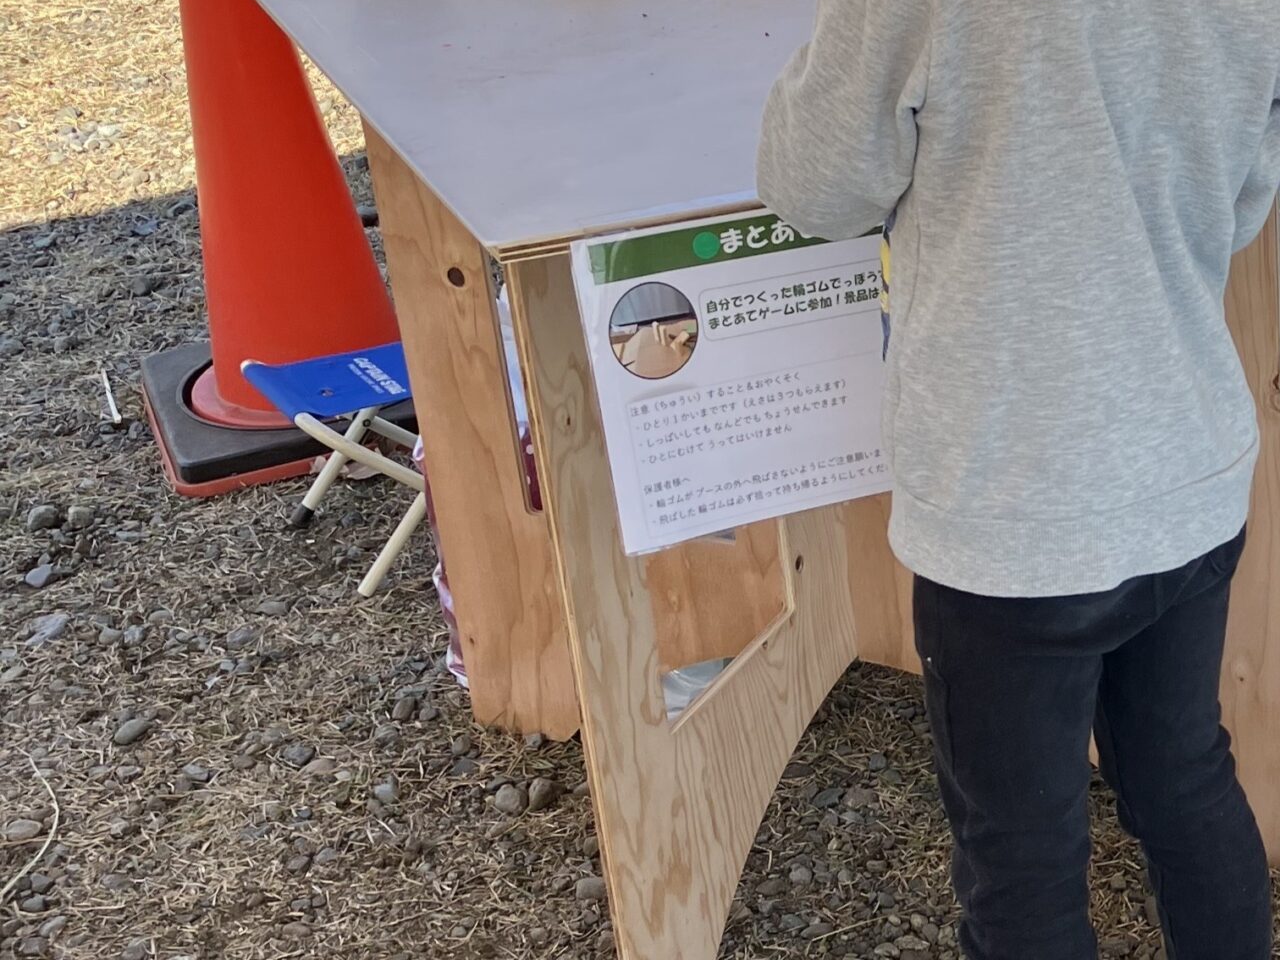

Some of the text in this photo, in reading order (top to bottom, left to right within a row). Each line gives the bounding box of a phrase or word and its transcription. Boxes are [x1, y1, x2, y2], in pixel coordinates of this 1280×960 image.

[720, 220, 815, 254] まとあ
[706, 270, 884, 314] 自分でつくった輪ゴムでっぽう
